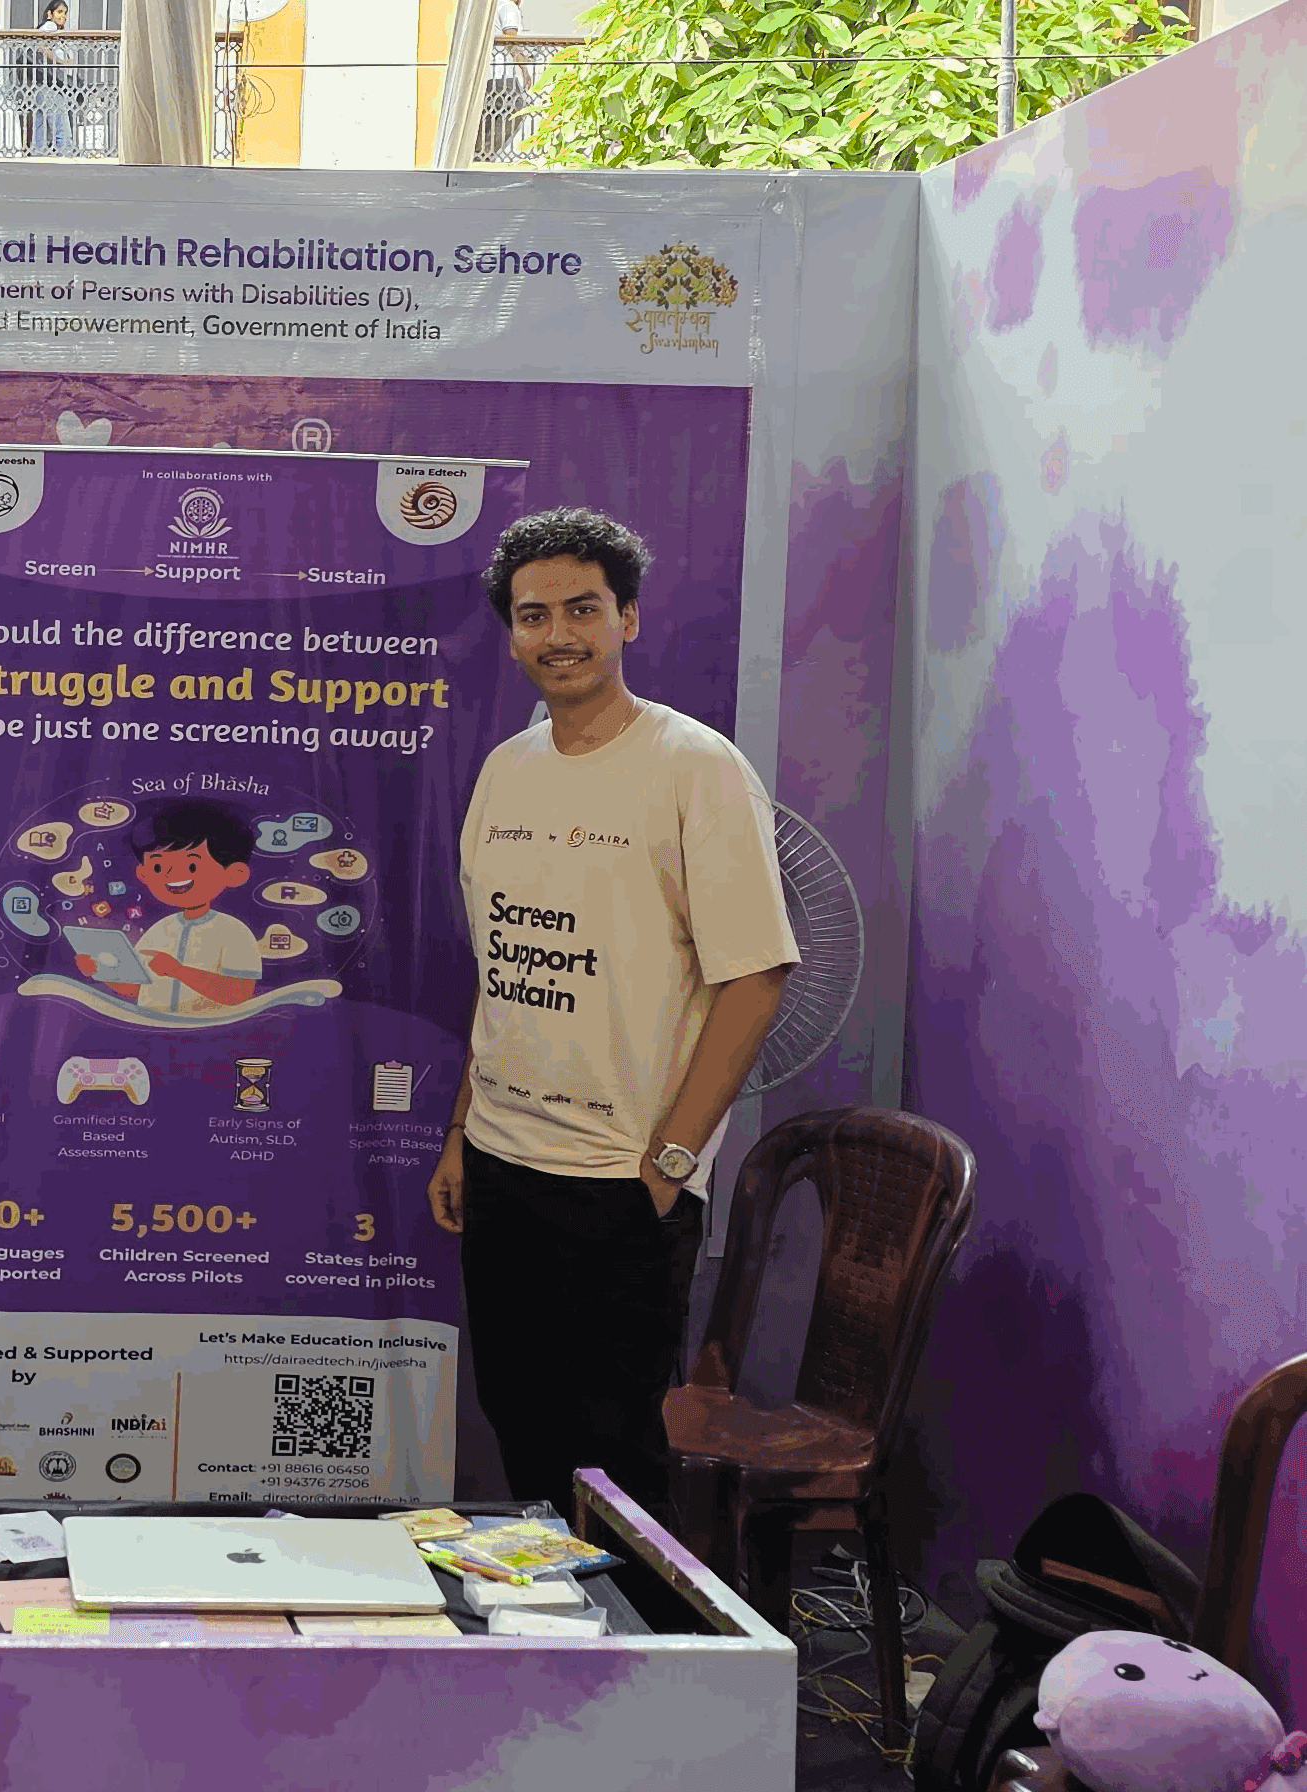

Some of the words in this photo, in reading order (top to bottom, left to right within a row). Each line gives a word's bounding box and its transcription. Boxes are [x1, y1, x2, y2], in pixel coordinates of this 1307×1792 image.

[46, 234, 167, 267] Health
[177, 237, 444, 278] Rehabilitation,
[453, 243, 583, 277] Sehore
[50, 278, 75, 301] of
[82, 280, 176, 303] Persons
[183, 282, 235, 305] with
[242, 282, 371, 308] Disabilities
[18, 309, 196, 339] Empowerment,
[202, 313, 349, 340] Government
[354, 317, 379, 340] of
[385, 320, 442, 342] India
[142, 469, 154, 480] In
[156, 470, 244, 482] collaborations
[395, 466, 425, 476] Daira
[427, 468, 468, 478] Edtech
[169, 541, 228, 555] NIMHR
[24, 560, 97, 577] Screen
[154, 563, 242, 584] Support
[307, 567, 387, 585] Sustain
[71, 621, 123, 647] the
[133, 622, 292, 653] difference
[303, 626, 439, 656] between
[169, 666, 253, 702] and
[268, 670, 450, 714] Support
[32, 715, 93, 745] just
[101, 720, 159, 742] one
[170, 718, 320, 753] screening
[329, 723, 434, 756] away?
[131, 777, 166, 795] Sea
[588, 833, 630, 847] DAIRA
[488, 891, 576, 934] Screen
[487, 929, 598, 977] Support
[486, 967, 576, 1014] Sutain
[53, 1114, 116, 1127] Gamified
[119, 1115, 156, 1129] Story
[208, 1116, 243, 1132] Early
[245, 1117, 284, 1132] Signs
[348, 1121, 432, 1136] Handwriting
[82, 1131, 125, 1143] Based
[209, 1133, 263, 1147] Autism,
[266, 1134, 298, 1148] SLD,
[348, 1136, 396, 1151] Speech
[400, 1138, 443, 1153] Based
[57, 1146, 149, 1159] Assessments
[110, 1203, 258, 1239] 5,500+
[352, 1213, 376, 1242] 3
[99, 1247, 179, 1263] Children
[182, 1249, 271, 1265] Screened
[304, 1251, 364, 1268] States
[368, 1252, 418, 1270] being
[123, 1269, 187, 1283] Across
[190, 1269, 244, 1285] Pilots
[285, 1272, 361, 1289] covered
[385, 1273, 436, 1290] pilots
[241, 1332, 287, 1346] Make
[289, 1333, 375, 1349] Education
[377, 1335, 448, 1353] Inclusive
[22, 1346, 38, 1360] &
[42, 1345, 154, 1364] Supported
[223, 1352, 428, 1371] https://dairaedtech.in/jiveesha
[10, 1368, 37, 1386] by
[38, 1426, 95, 1437] BHASHINI
[260, 1463, 281, 1474] +91
[284, 1463, 324, 1475] 88616
[326, 1464, 370, 1476] 06450
[260, 1477, 281, 1487] +91
[283, 1476, 326, 1488] 94376
[328, 1478, 370, 1489] 27506
[209, 1491, 253, 1502] Email:
